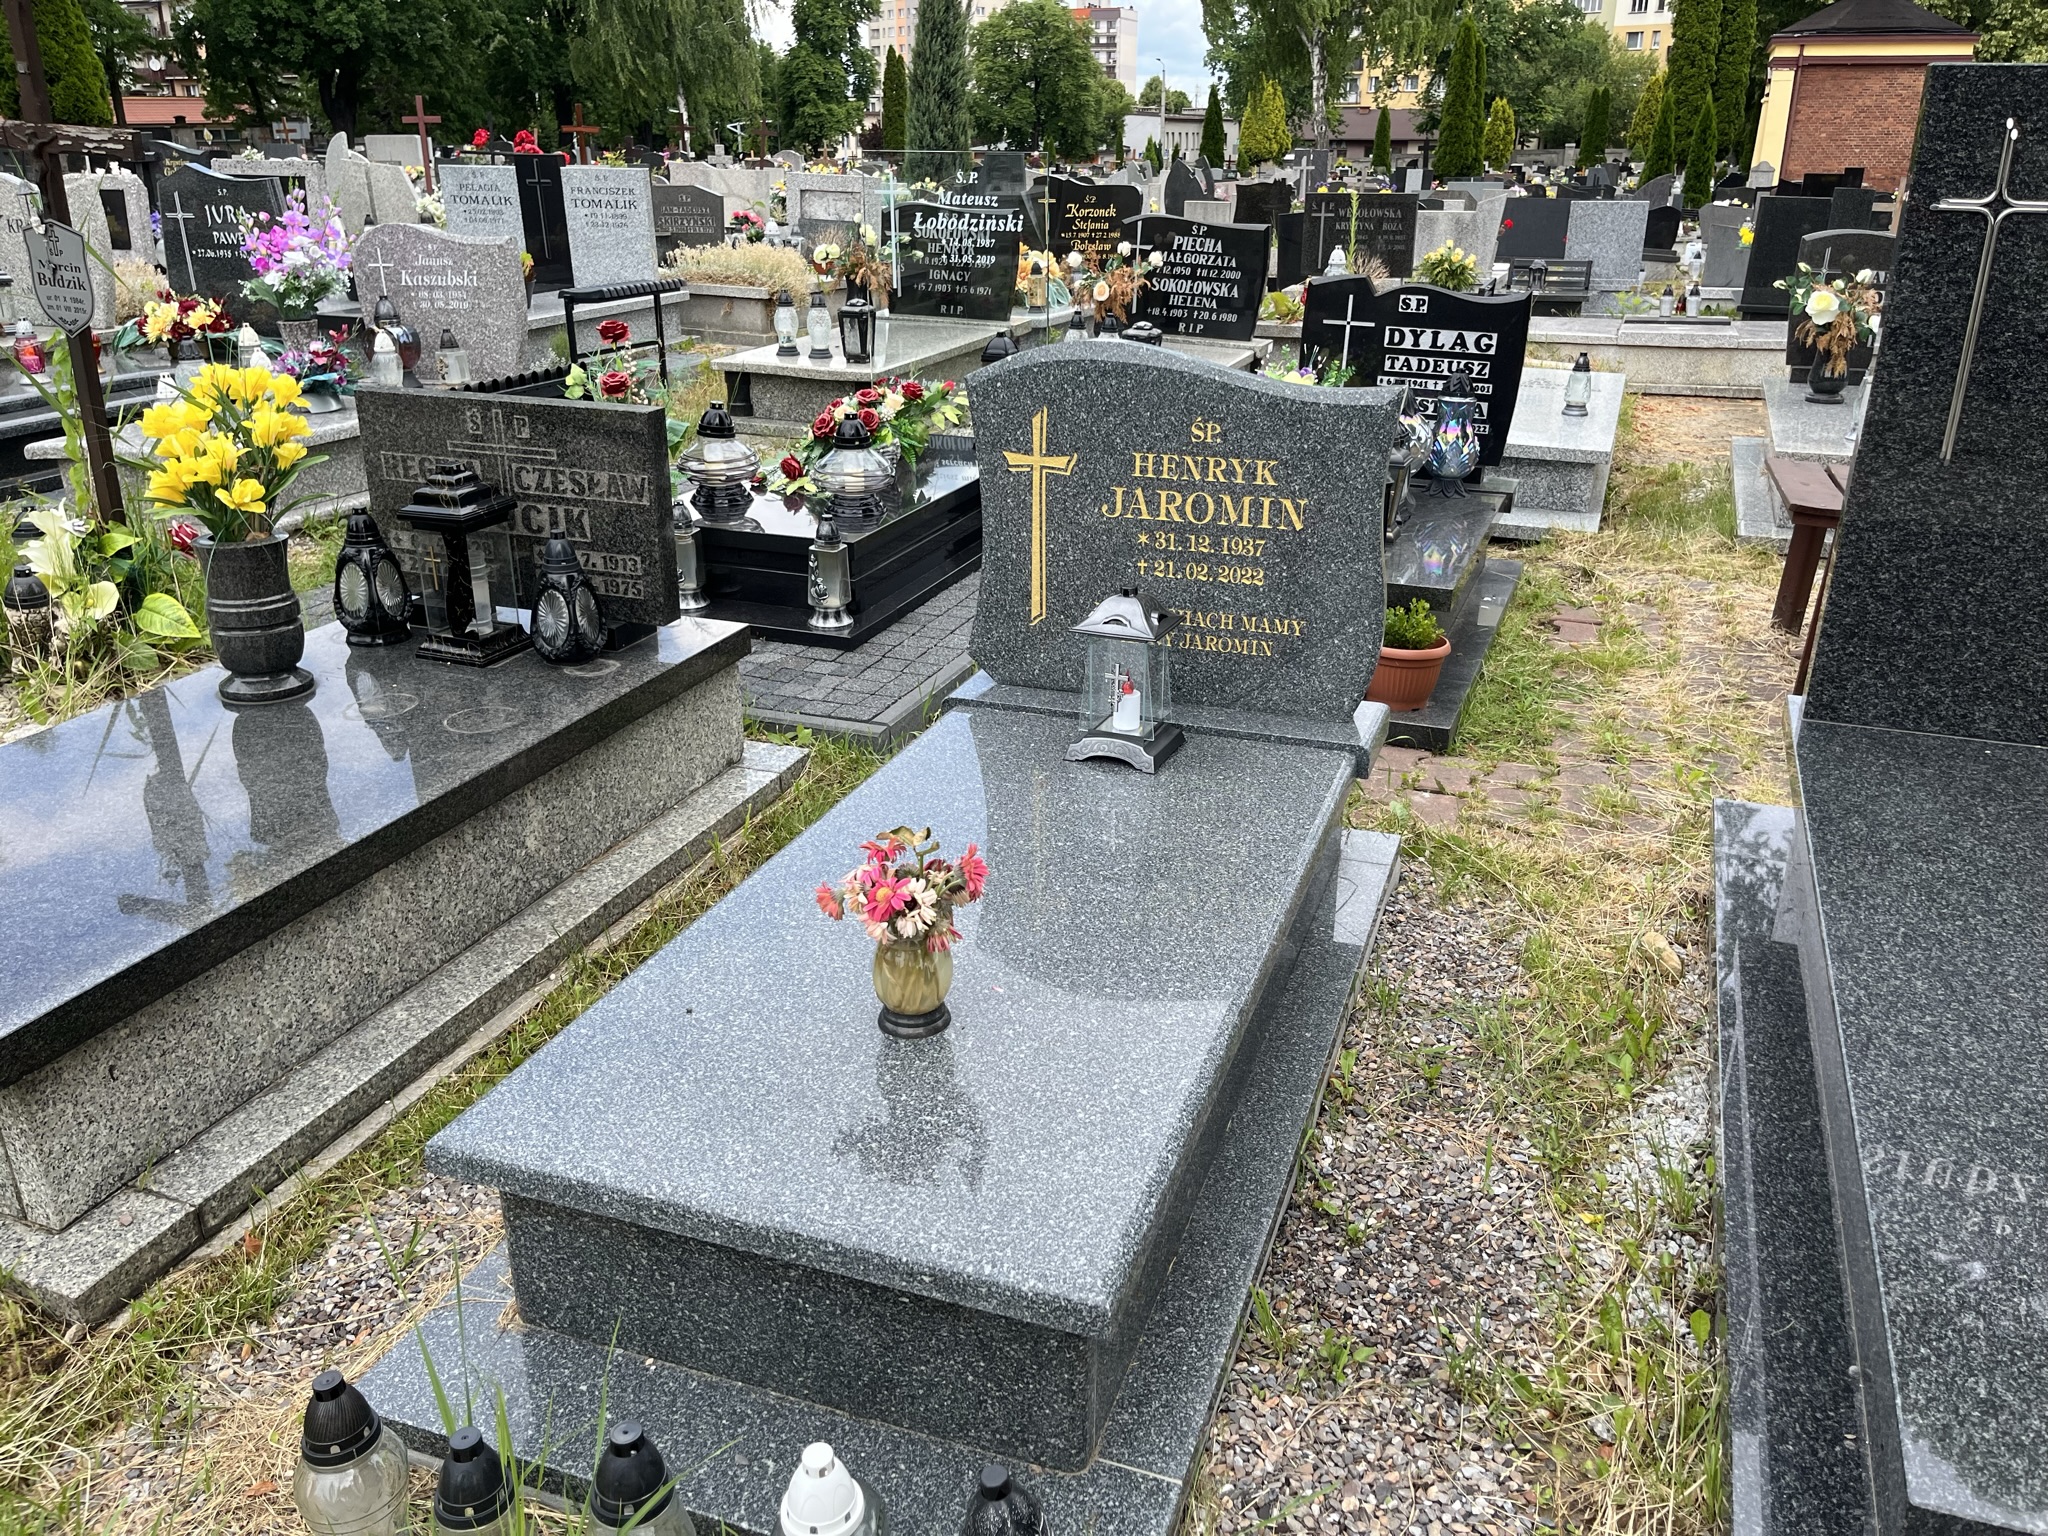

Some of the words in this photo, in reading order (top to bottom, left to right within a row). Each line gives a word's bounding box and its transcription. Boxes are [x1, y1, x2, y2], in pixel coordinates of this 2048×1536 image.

[459, 183, 501, 192] PELAGIA
[570, 187, 636, 196] FRANCISZEK
[450, 195, 513, 206] TOMALIK
[571, 199, 638, 210] TOMALIK
[937, 191, 999, 208] Mateusz
[1065, 203, 1117, 218] Korzonek
[1338, 207, 1402, 219] WEOŁOWSKA
[913, 212, 1024, 232] Łobodziński
[1072, 218, 1109, 232] Stefania
[1335, 221, 1374, 231] KRYTYNA
[212, 231, 246, 245] PAWE
[1172, 235, 1223, 253] PIECHA
[38, 259, 82, 273] Mrcin
[415, 254, 454, 266] Janusz
[1161, 251, 1237, 268] MAŁGORZATA
[37, 271, 87, 291] Budzik
[400, 269, 478, 287] Kaszubski
[929, 269, 971, 282] IGNACY
[1151, 277, 1239, 299] SOKOŁOWSKA
[1168, 294, 1218, 309] HELENA
[1387, 355, 1489, 377] TADEUSZ
[1131, 451, 1278, 486] HENRYK
[514, 465, 648, 501] CZESŁAW
[1101, 486, 1308, 531] JAROMIN
[1241, 615, 1308, 636] MAMY
[1179, 633, 1274, 657] JAROMIN
